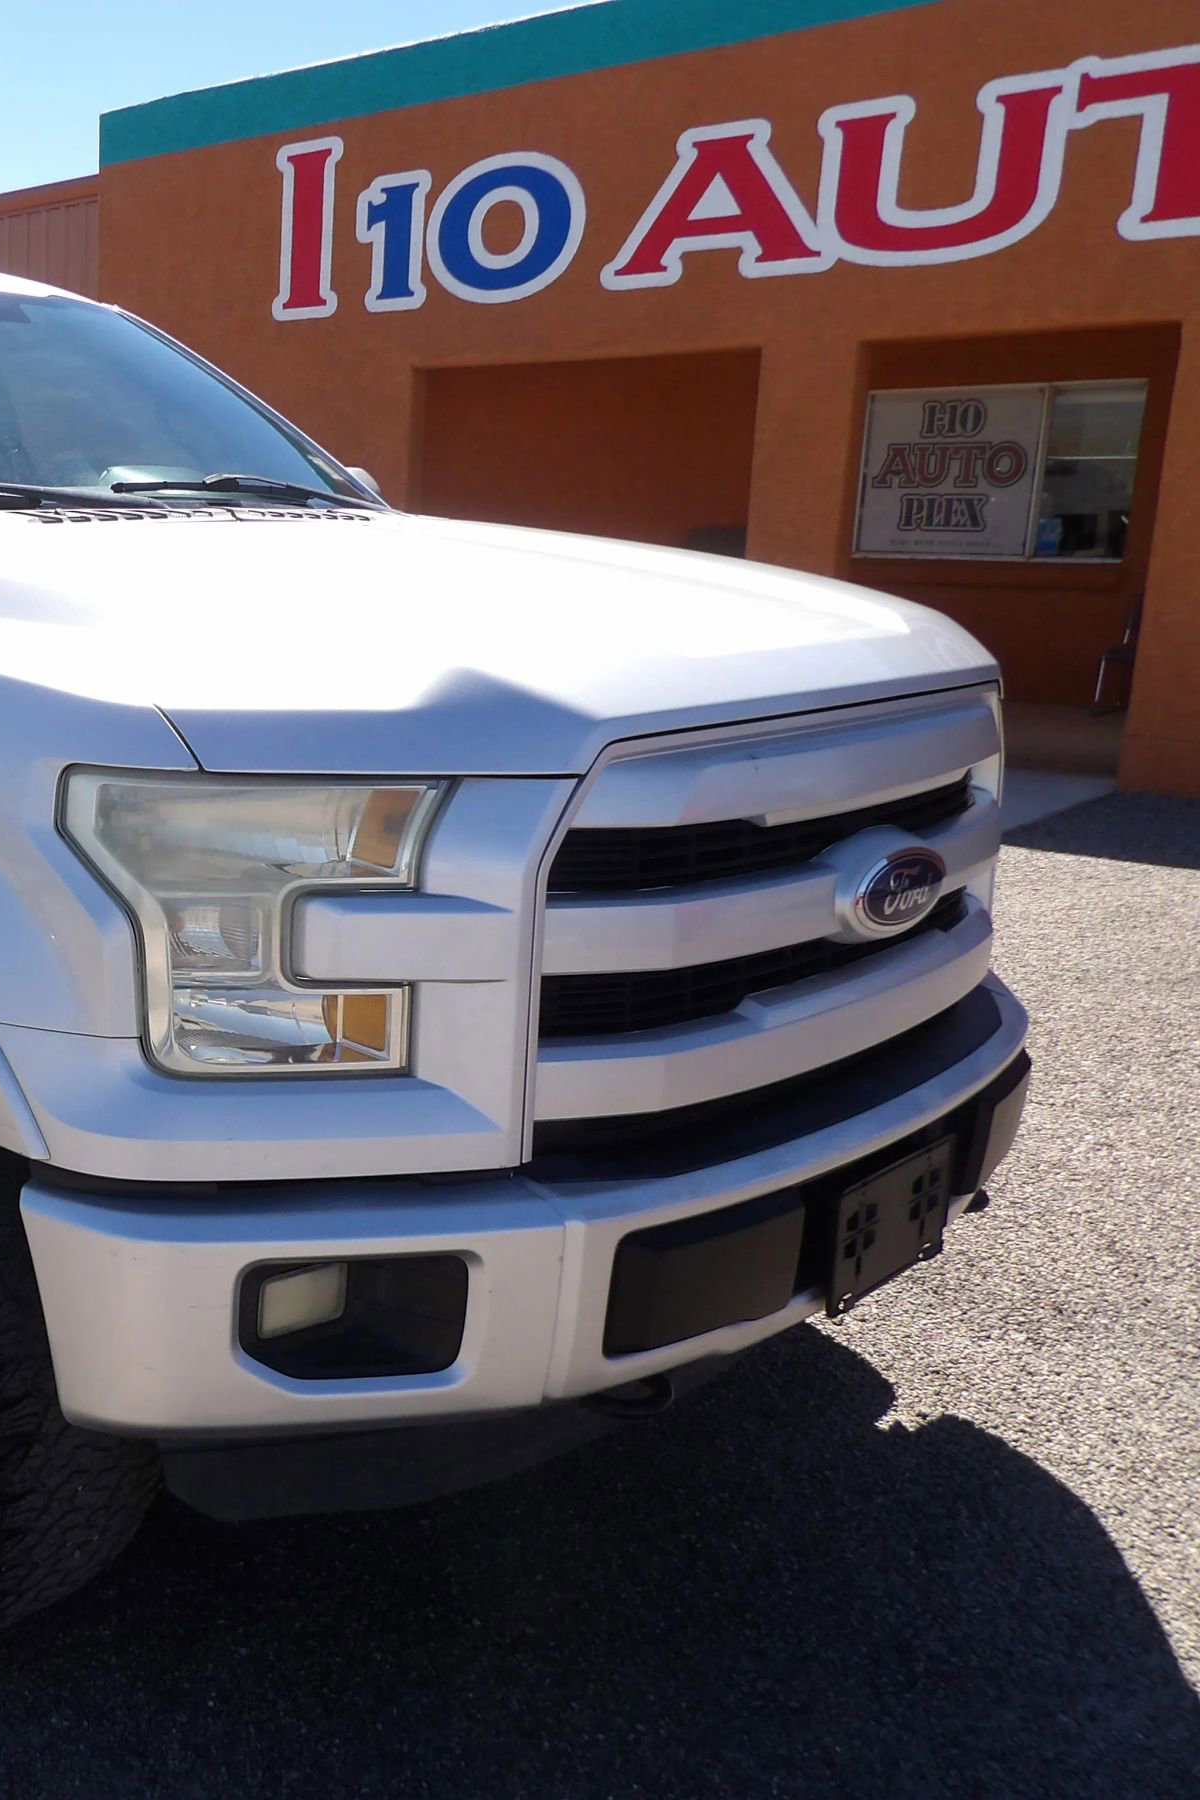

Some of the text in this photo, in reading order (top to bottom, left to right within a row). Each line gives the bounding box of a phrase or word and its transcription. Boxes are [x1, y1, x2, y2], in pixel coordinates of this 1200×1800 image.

[871, 441, 1028, 488] AUTO
[898, 494, 986, 532] PLEX
[883, 866, 932, 915] Ford
